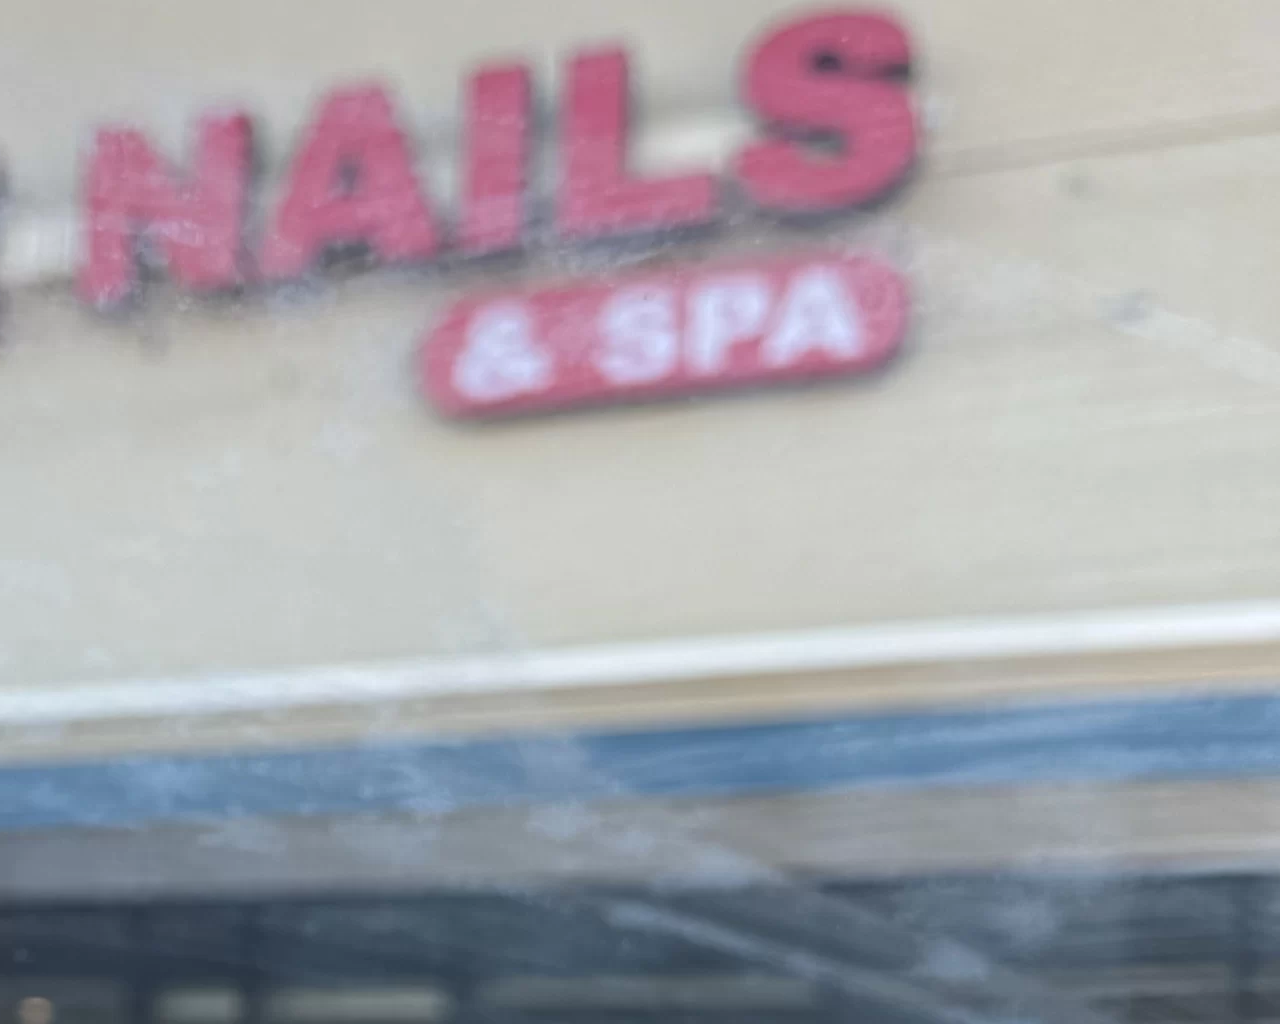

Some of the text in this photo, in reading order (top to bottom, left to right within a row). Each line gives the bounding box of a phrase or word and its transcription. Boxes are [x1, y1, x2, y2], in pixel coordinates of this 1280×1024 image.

[78, 8, 920, 304] NAILS
[455, 266, 862, 400] & SPA
